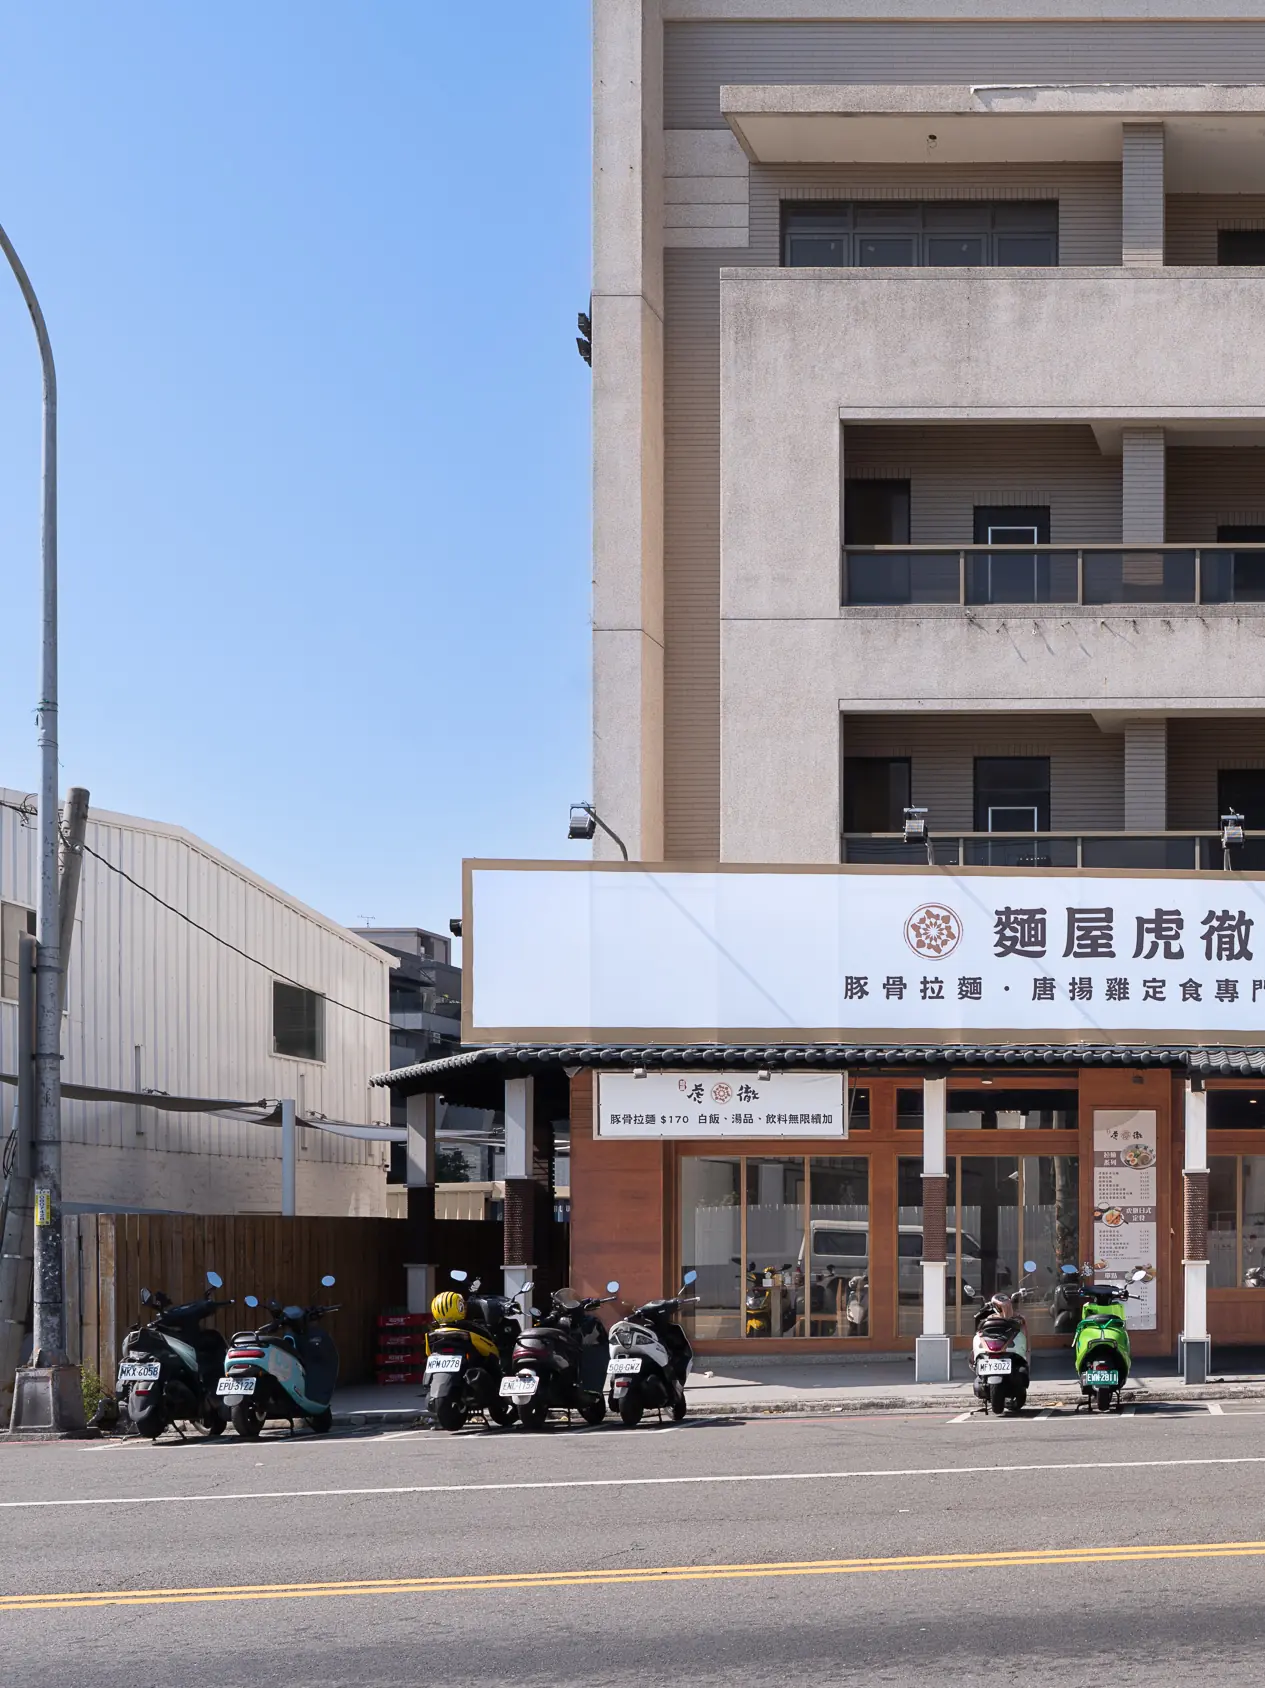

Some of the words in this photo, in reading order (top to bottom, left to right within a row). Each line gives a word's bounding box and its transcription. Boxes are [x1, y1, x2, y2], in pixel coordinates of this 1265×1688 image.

[993, 906, 1255, 961] 麵屋虎徹
[610, 1113, 656, 1125] 豚骨拉麵
[660, 1114, 689, 1125] $170
